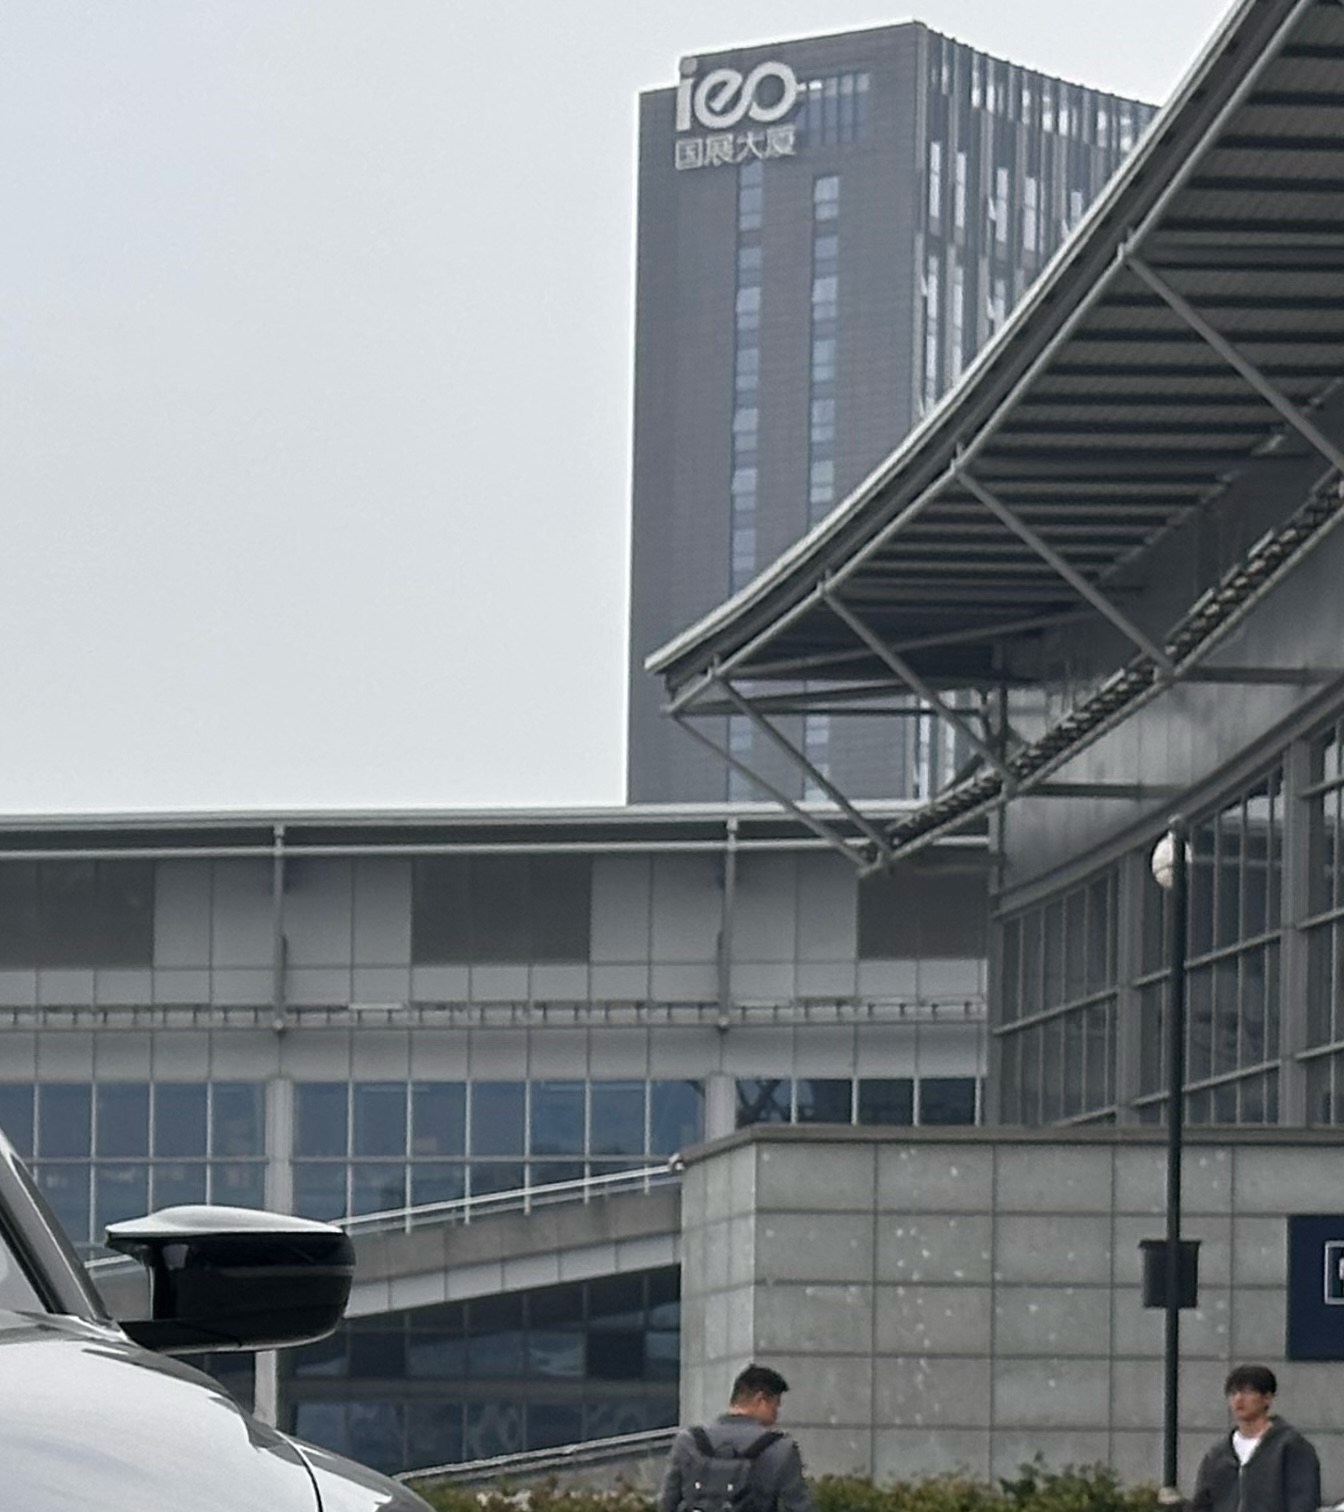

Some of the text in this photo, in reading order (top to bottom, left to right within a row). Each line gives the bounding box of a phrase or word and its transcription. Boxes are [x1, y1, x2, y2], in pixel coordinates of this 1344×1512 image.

[676, 58, 797, 131] ieo
[675, 124, 796, 170] 国展大厦
